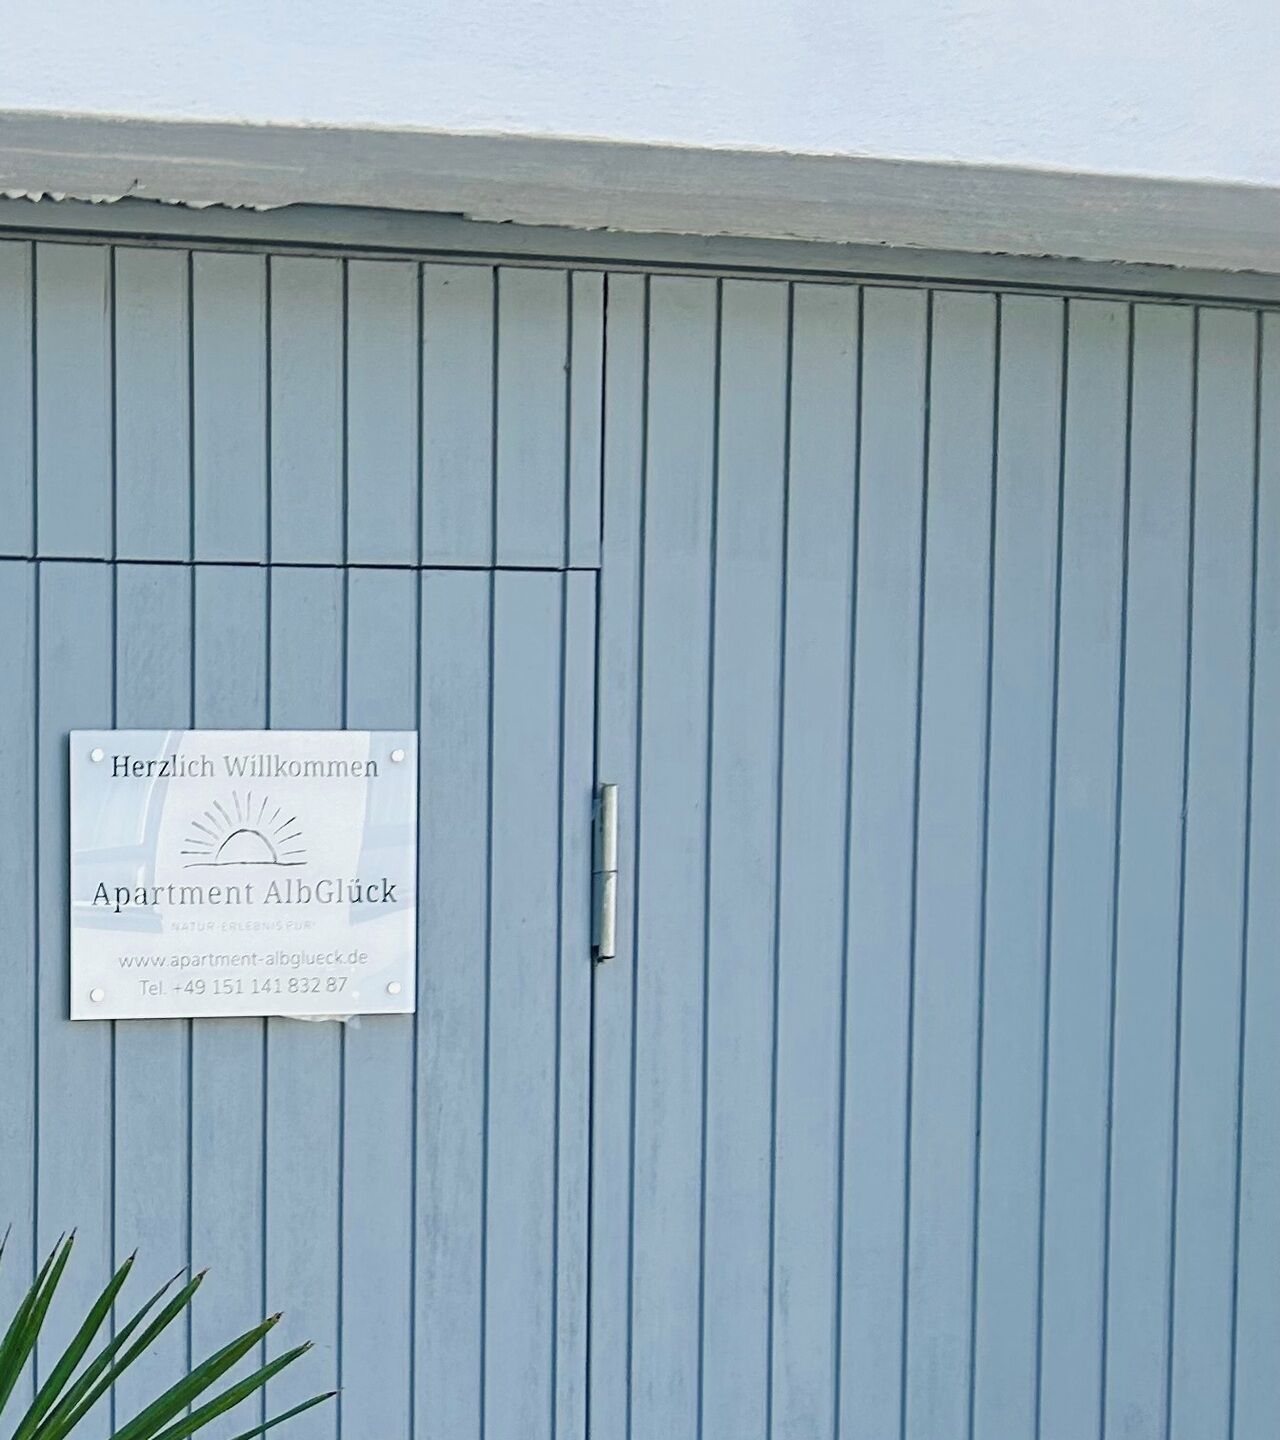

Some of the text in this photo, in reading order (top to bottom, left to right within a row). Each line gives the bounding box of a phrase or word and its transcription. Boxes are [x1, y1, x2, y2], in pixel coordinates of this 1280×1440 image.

[111, 754, 379, 778] Herzlich Willkommen
[91, 878, 398, 912] Apartment AlbGlück
[118, 950, 368, 969] www.apartment-albglueck.de
[173, 979, 206, 995] +49
[213, 978, 243, 995] 151
[251, 978, 281, 994] 141
[288, 977, 320, 993] 832
[326, 976, 349, 993] 87
